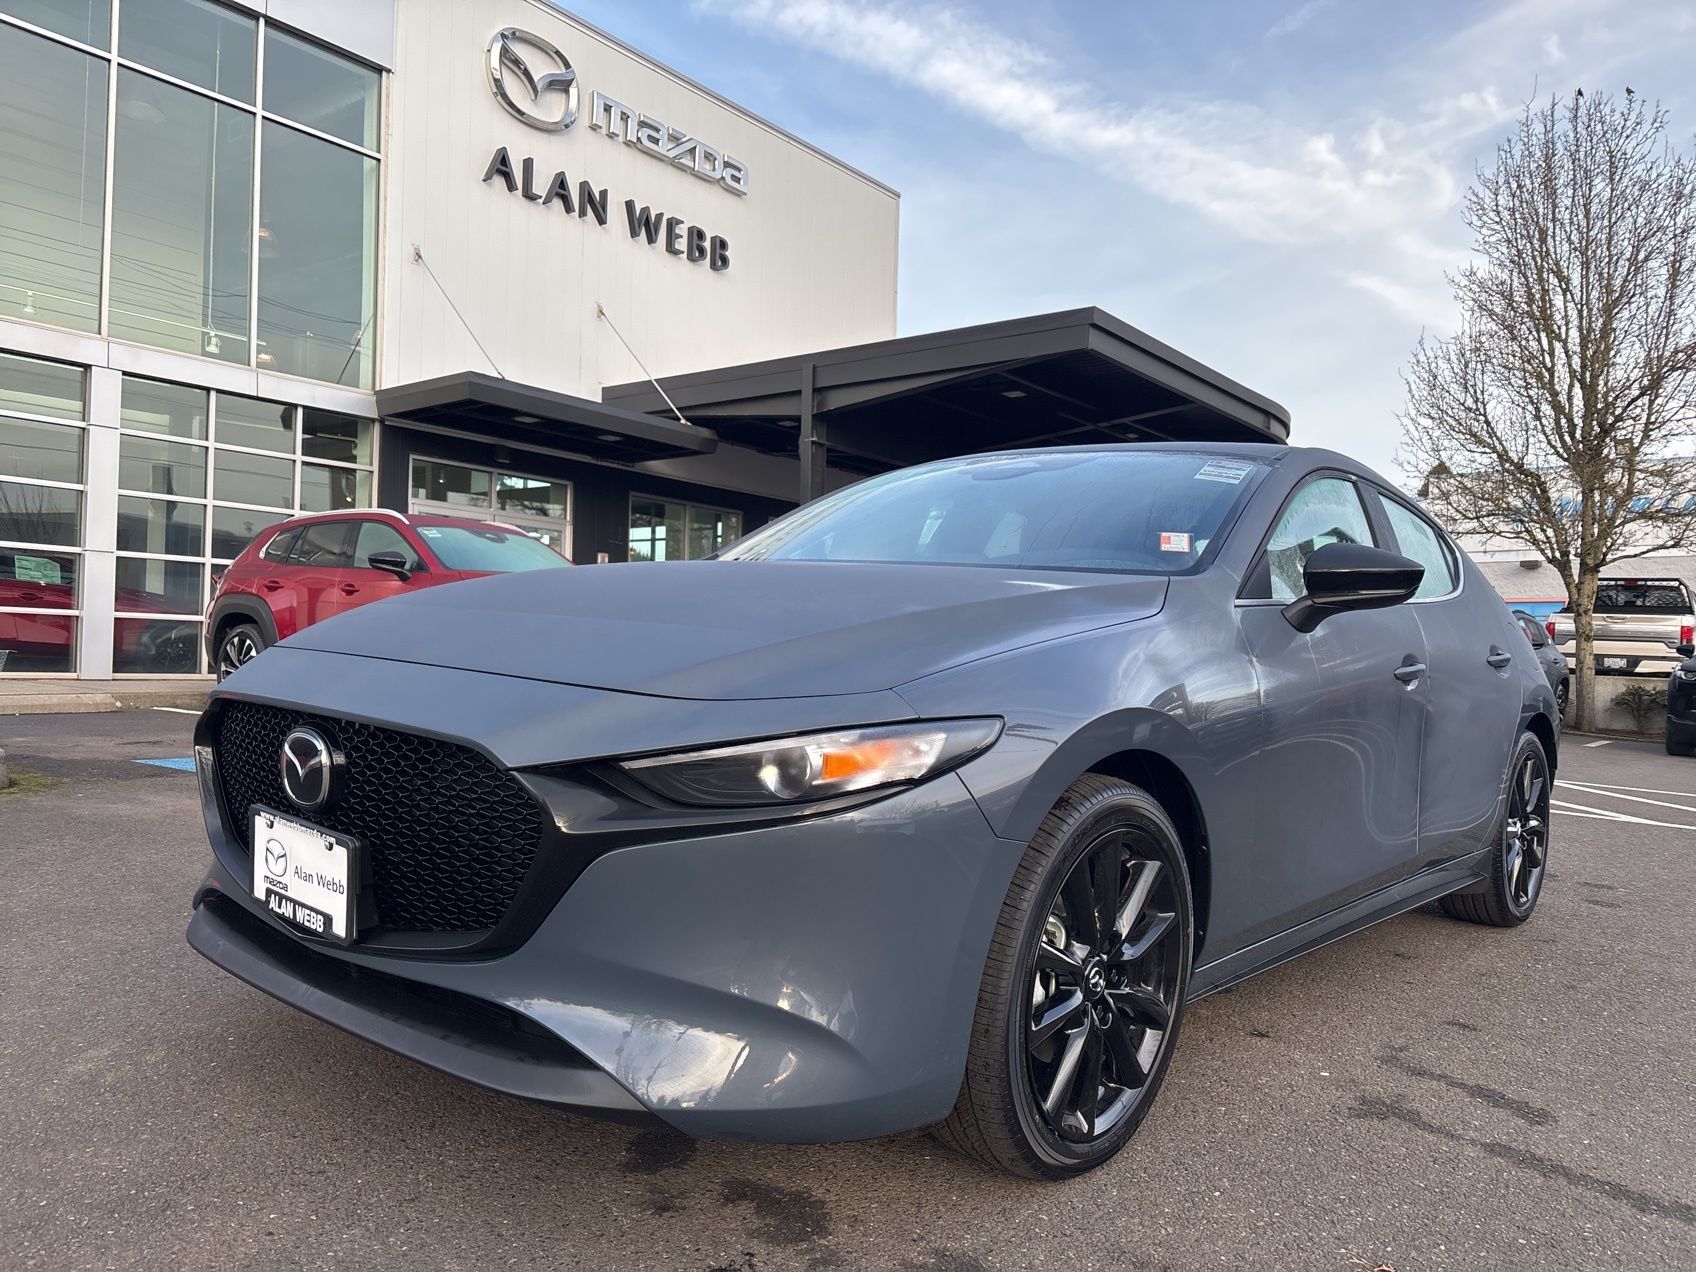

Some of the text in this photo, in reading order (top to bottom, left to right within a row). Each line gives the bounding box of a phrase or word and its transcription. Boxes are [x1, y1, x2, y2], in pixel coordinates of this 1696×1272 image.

[588, 90, 749, 198] mazda
[482, 146, 731, 271] ALAN WEBB
[263, 875, 289, 892] mazda
[293, 865, 345, 895] Alan Webb
[268, 894, 324, 933] ALAN WEBB
